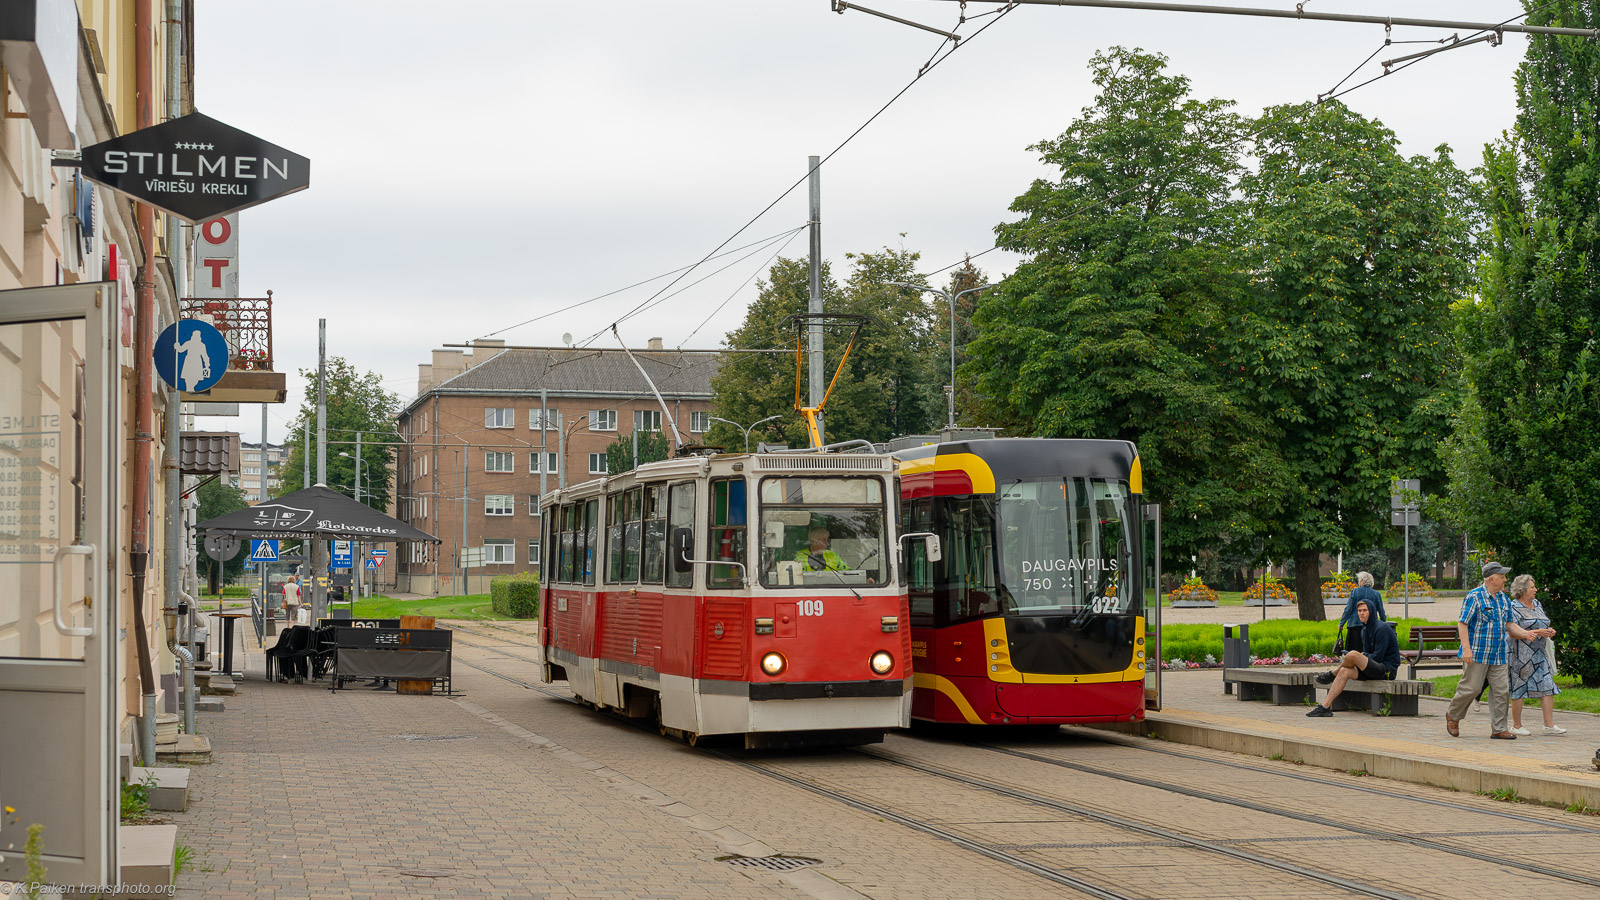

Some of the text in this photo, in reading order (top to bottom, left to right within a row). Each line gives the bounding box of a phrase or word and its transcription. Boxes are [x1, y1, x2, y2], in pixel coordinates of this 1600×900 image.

[103, 151, 288, 180] STILMEN
[145, 178, 248, 196] VĪRIEŠU KREKLI
[785, 564, 794, 585] 1
[1022, 558, 1118, 573] DAUGAVPILS
[1023, 578, 1052, 591] 750
[796, 600, 824, 616] 109
[1092, 596, 1120, 614] 022
